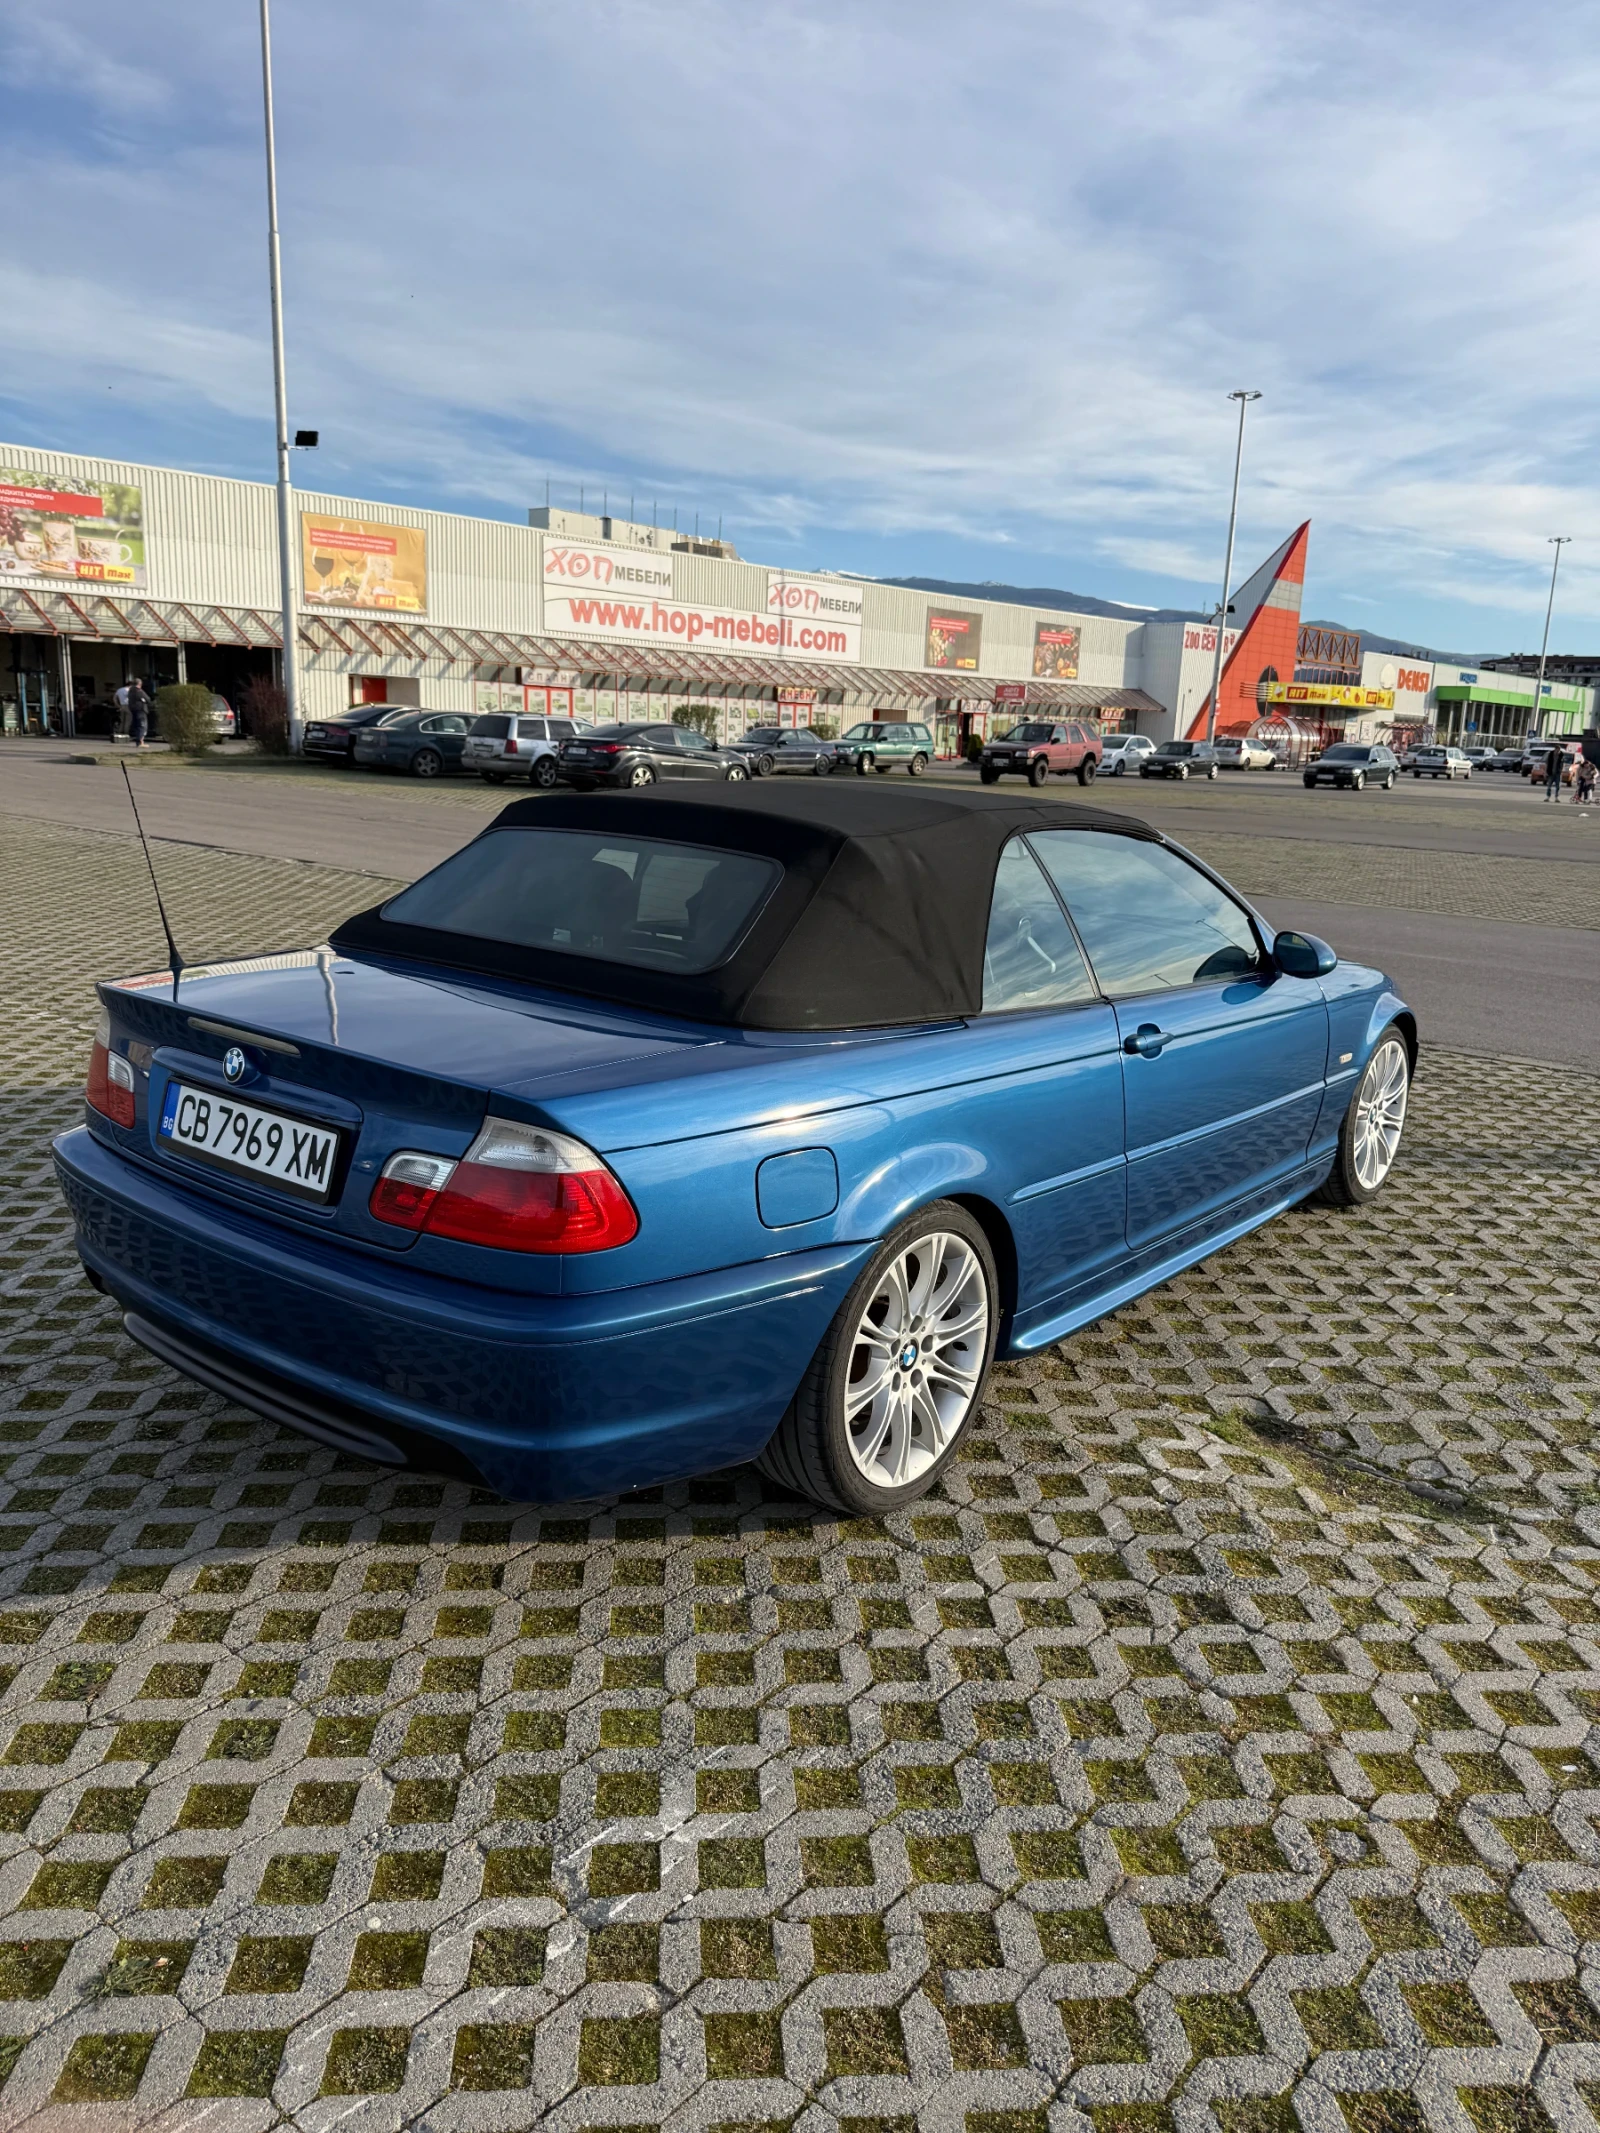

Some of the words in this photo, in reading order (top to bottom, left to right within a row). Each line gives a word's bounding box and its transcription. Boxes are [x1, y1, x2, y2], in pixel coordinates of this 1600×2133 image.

[80, 565, 102, 577] HIT
[545, 549, 614, 585] ХОП
[615, 566, 671, 587] МЕБЕЛИ
[379, 596, 395, 606] HIT
[769, 583, 819, 614] ХОП
[820, 597, 862, 614] МЕБЕЛИ
[568, 598, 847, 653] www.hop-mebeli.com
[1184, 630, 1200, 650] ZOO
[1201, 633, 1229, 653] CENR
[780, 689, 818, 701] ДНЕВНИ
[1288, 688, 1307, 698] HIT
[162, 1116, 174, 1131] BG
[177, 1095, 211, 1143] CB
[212, 1105, 284, 1166] 7969
[284, 1128, 331, 1184] XM
